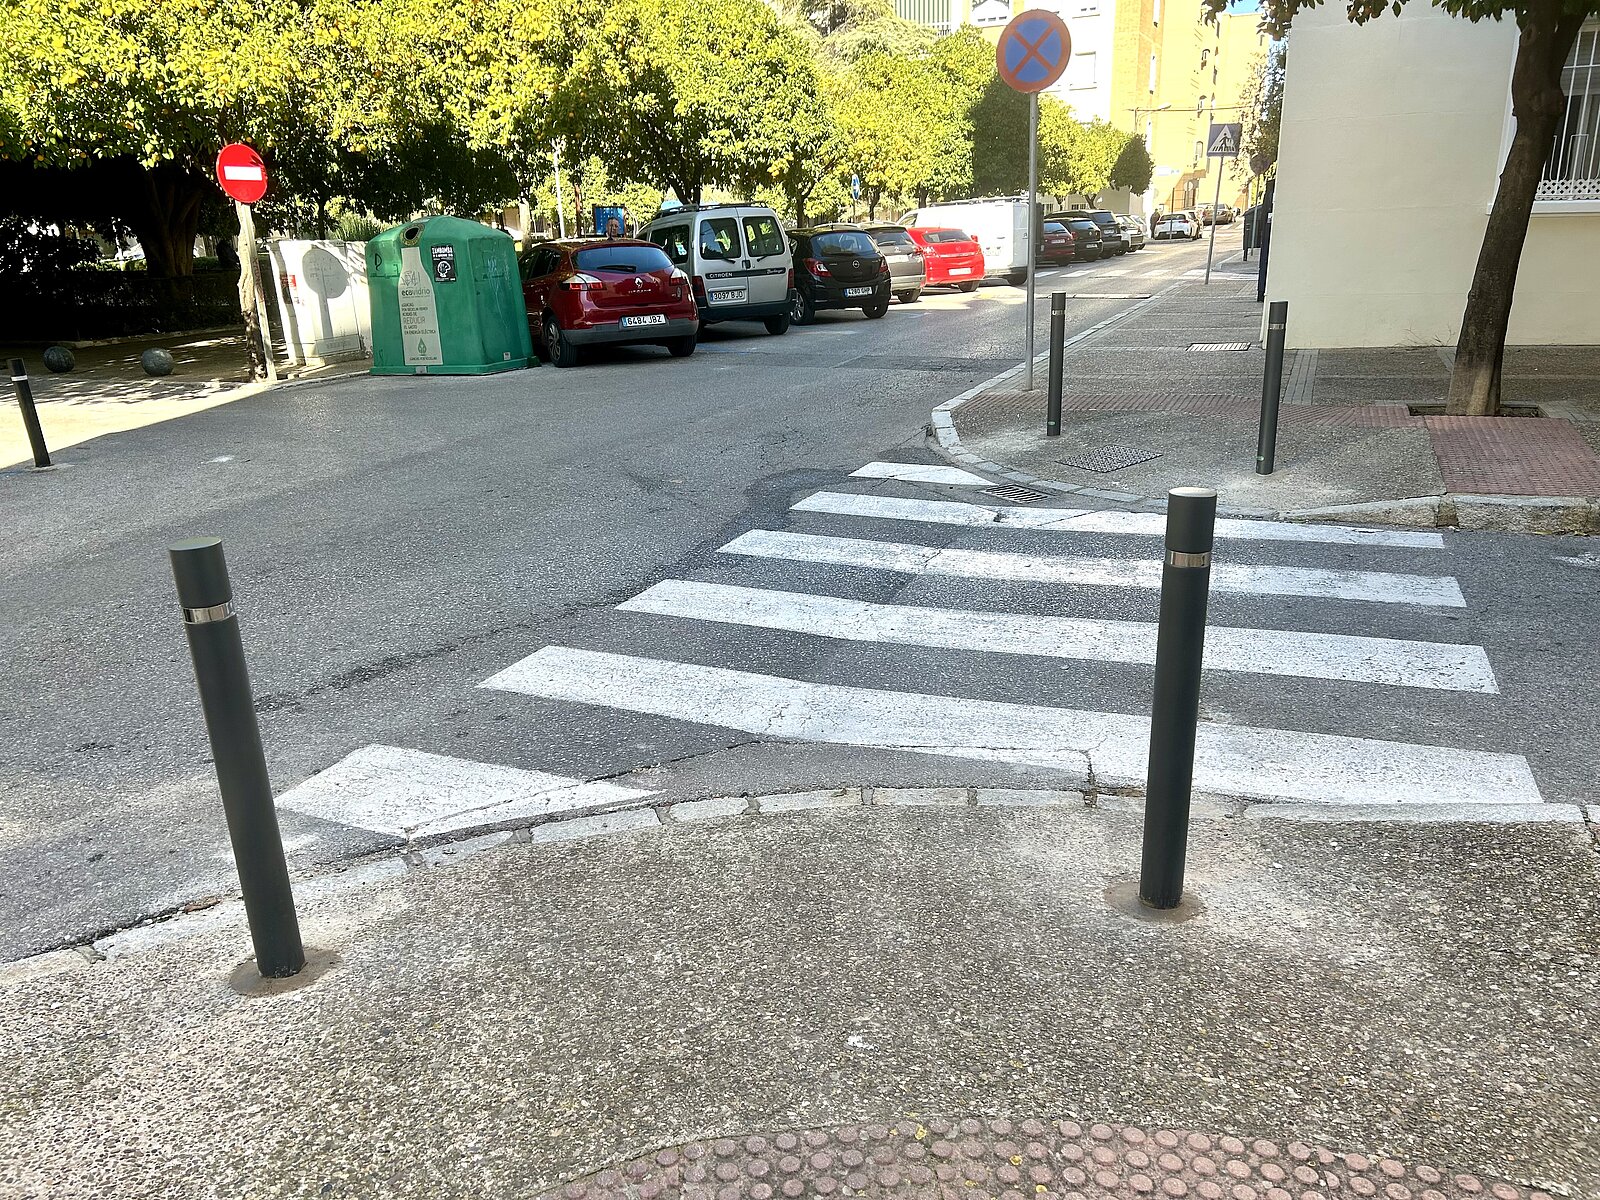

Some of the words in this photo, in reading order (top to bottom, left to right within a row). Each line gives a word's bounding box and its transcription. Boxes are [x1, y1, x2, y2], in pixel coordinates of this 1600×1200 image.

[401, 287, 430, 296] ecovidrio
[713, 292, 729, 300] 3097
[403, 316, 425, 324] REDUCIR
[627, 316, 647, 326] 6484
[648, 315, 662, 324] JBZ
